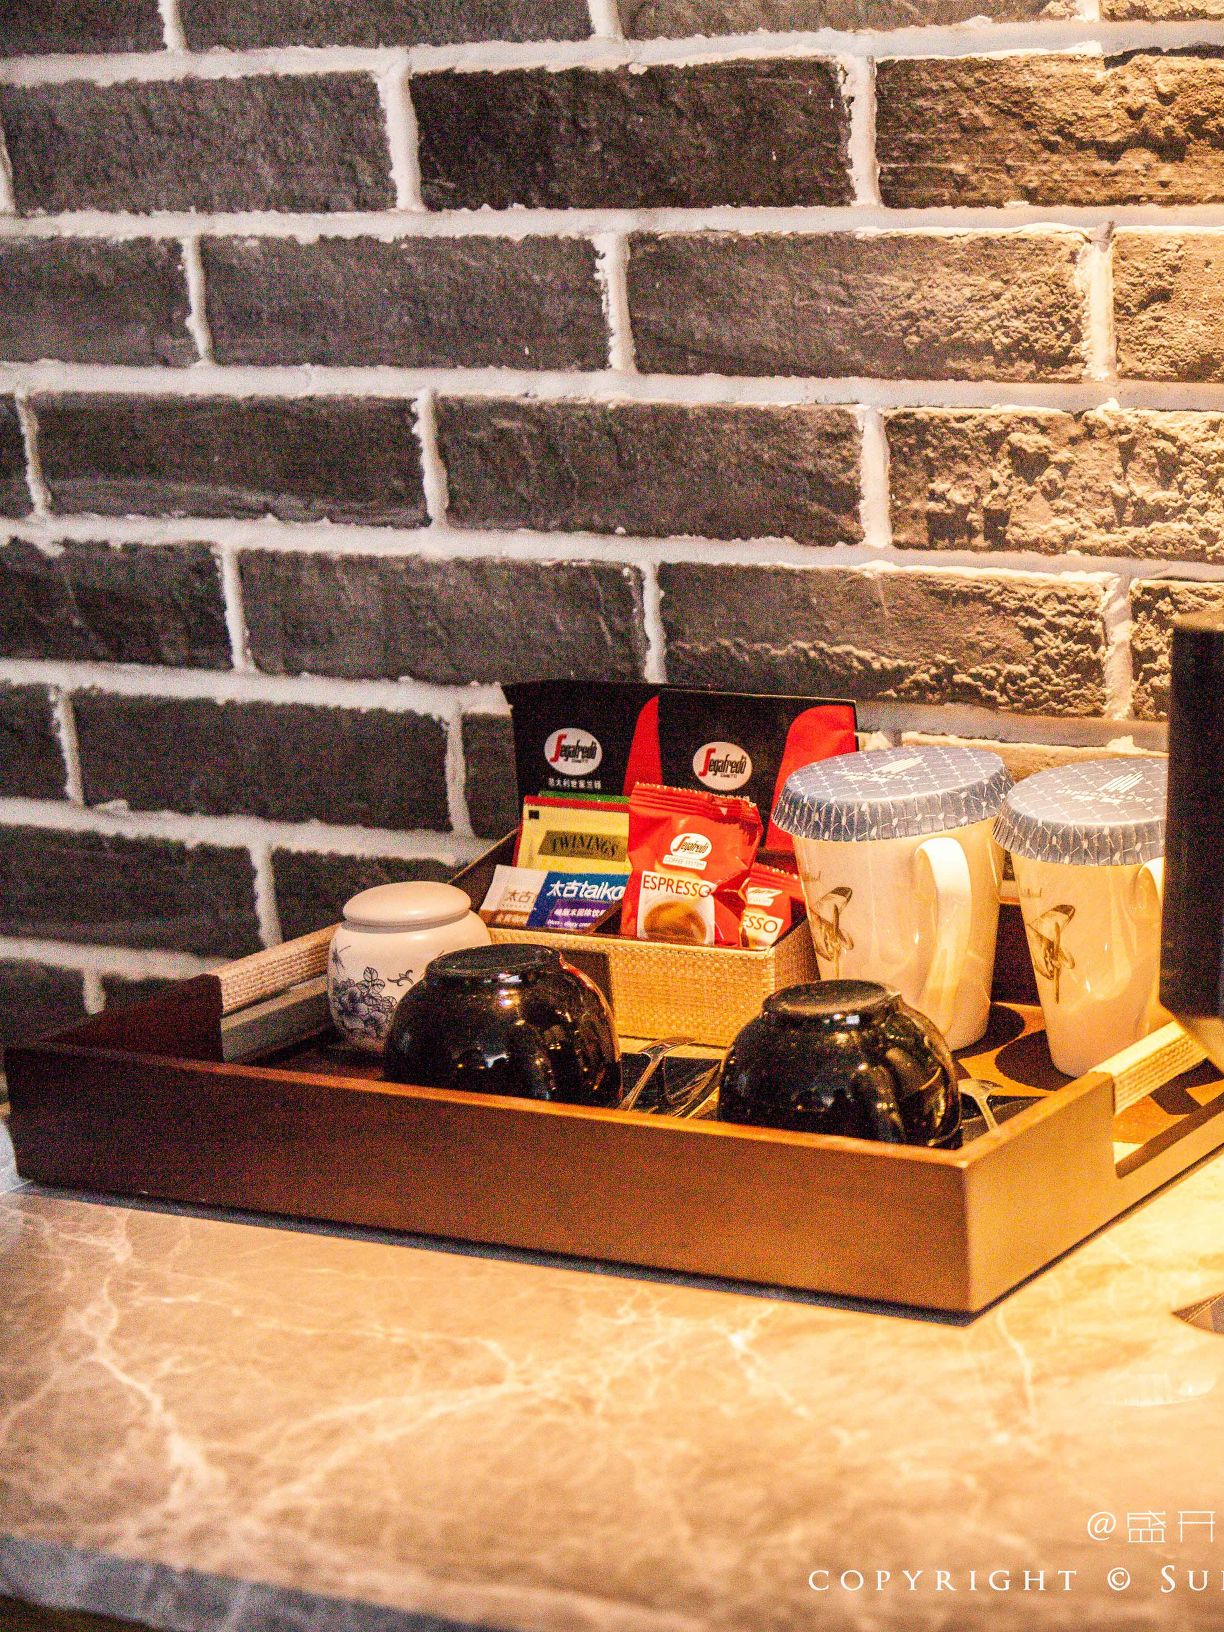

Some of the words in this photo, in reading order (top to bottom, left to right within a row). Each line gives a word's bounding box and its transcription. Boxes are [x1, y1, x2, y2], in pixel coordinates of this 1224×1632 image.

[698, 747, 747, 777] Segafredo
[551, 834, 619, 857] TWININGS
[642, 874, 712, 898] ESPRESSO
